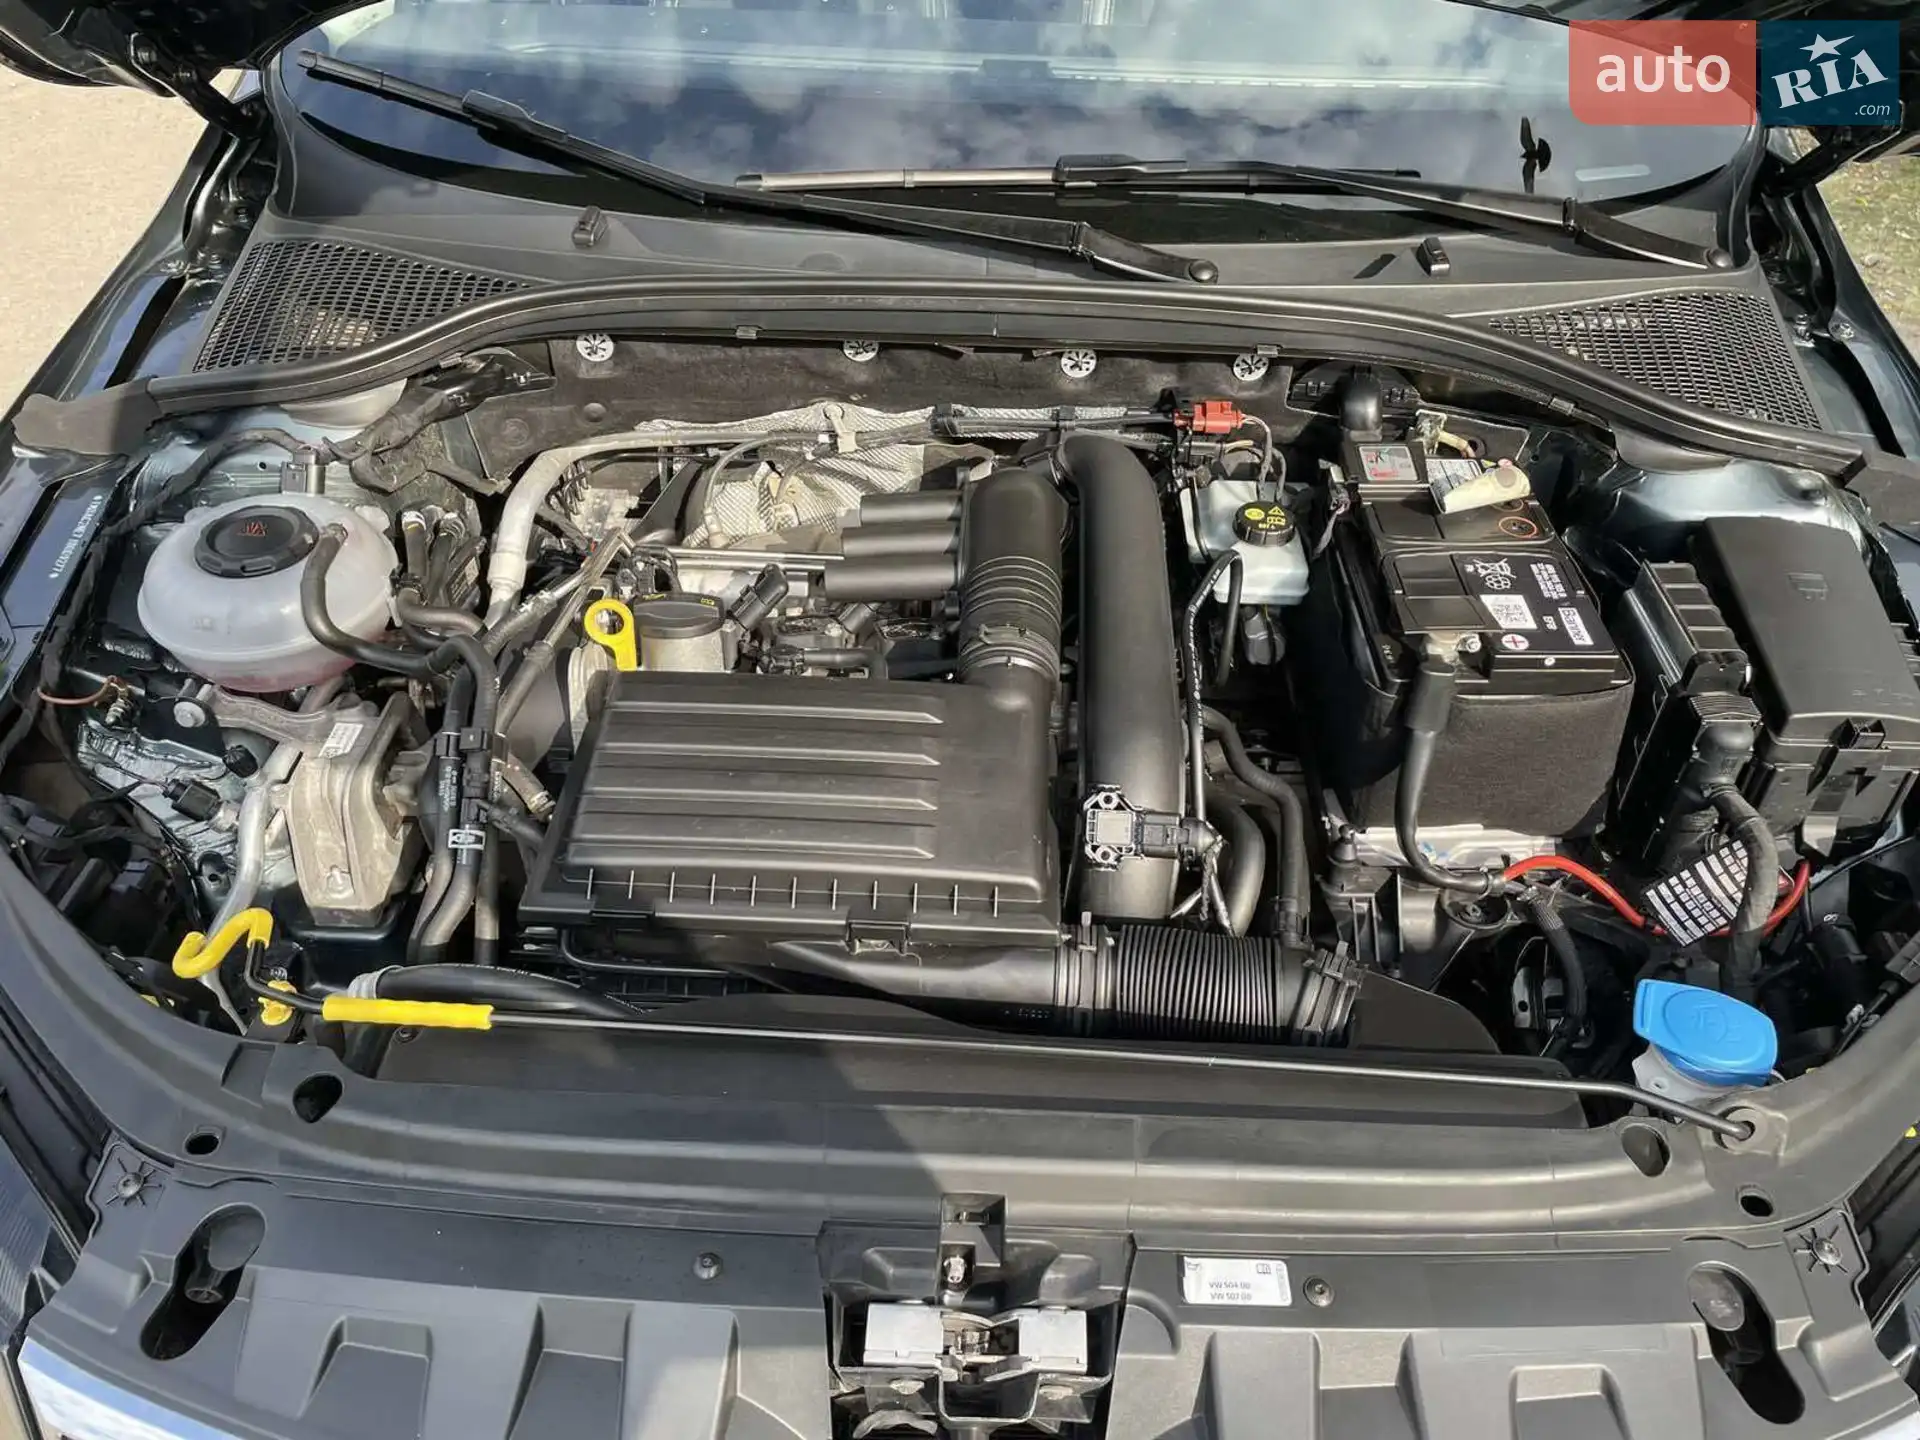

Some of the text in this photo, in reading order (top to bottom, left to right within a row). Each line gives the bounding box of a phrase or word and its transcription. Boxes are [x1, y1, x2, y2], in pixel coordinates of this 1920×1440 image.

[1209, 1281, 1223, 1289] VW
[1224, 1281, 1238, 1289] 504
[1210, 1292, 1225, 1300] VW
